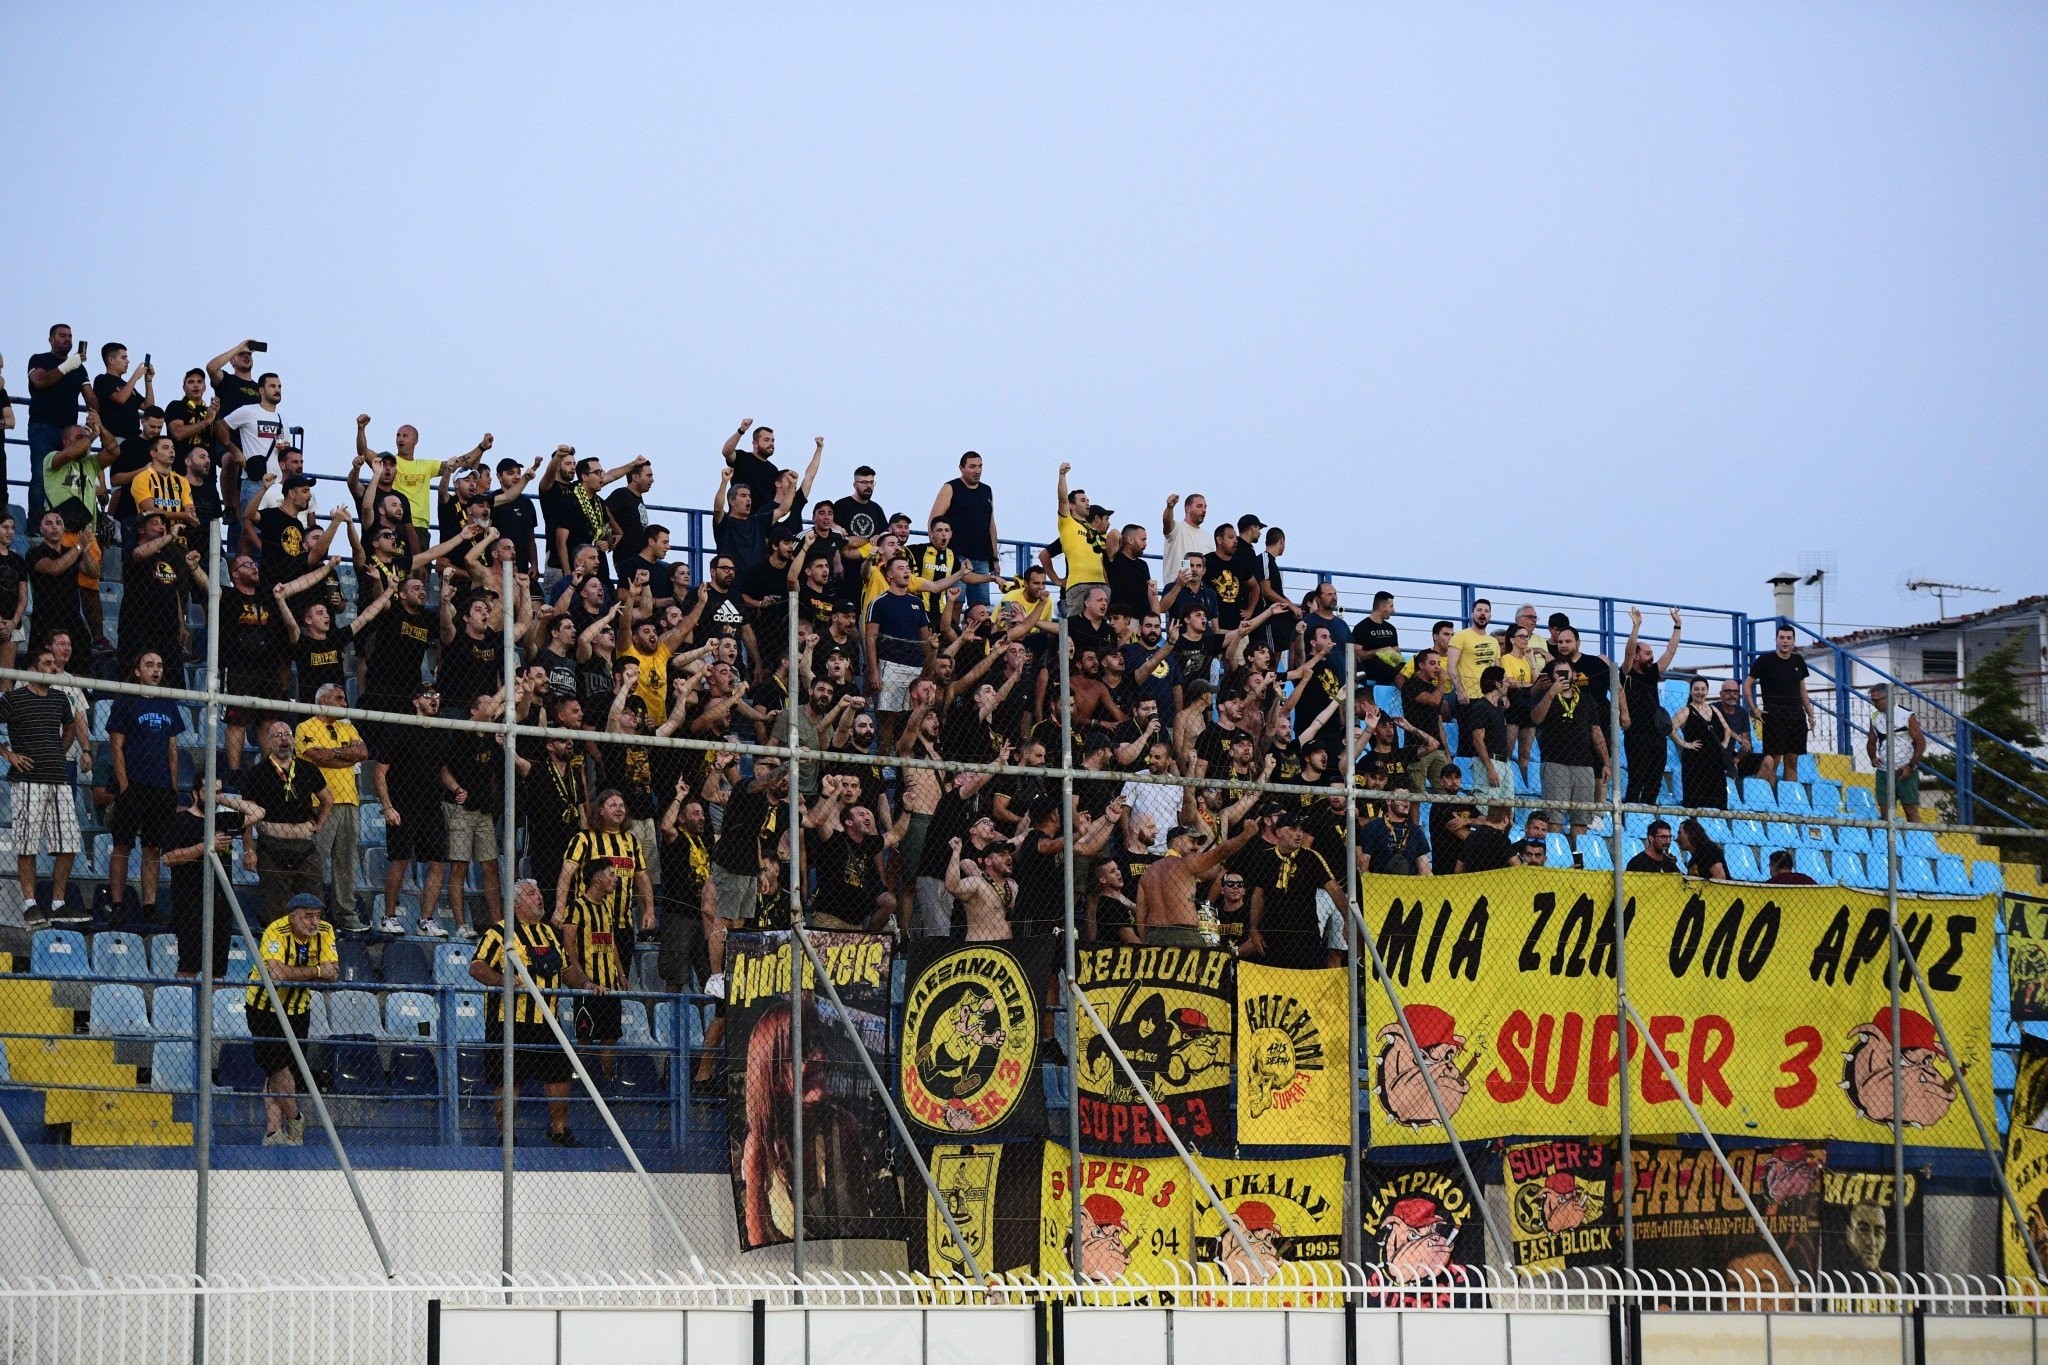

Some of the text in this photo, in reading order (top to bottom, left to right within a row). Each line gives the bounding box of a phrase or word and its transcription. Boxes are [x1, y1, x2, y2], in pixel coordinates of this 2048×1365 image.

[1372, 892, 1977, 993] ΜΙΑ ΖΩΗ ΟΛΟ ΑΡΗΣ
[1486, 1009, 1823, 1110] SUPER 3
[905, 1059, 1022, 1126] SUPER 3
[1051, 1160, 1176, 1208] SUPER 3
[1363, 1171, 1472, 1236] ΚΕΝΤΡΙΚΟΣ
[1043, 1216, 1180, 1257] 19 94
[1295, 1241, 1340, 1258] 1995
[1520, 1227, 1613, 1264] EAST BLOCK
